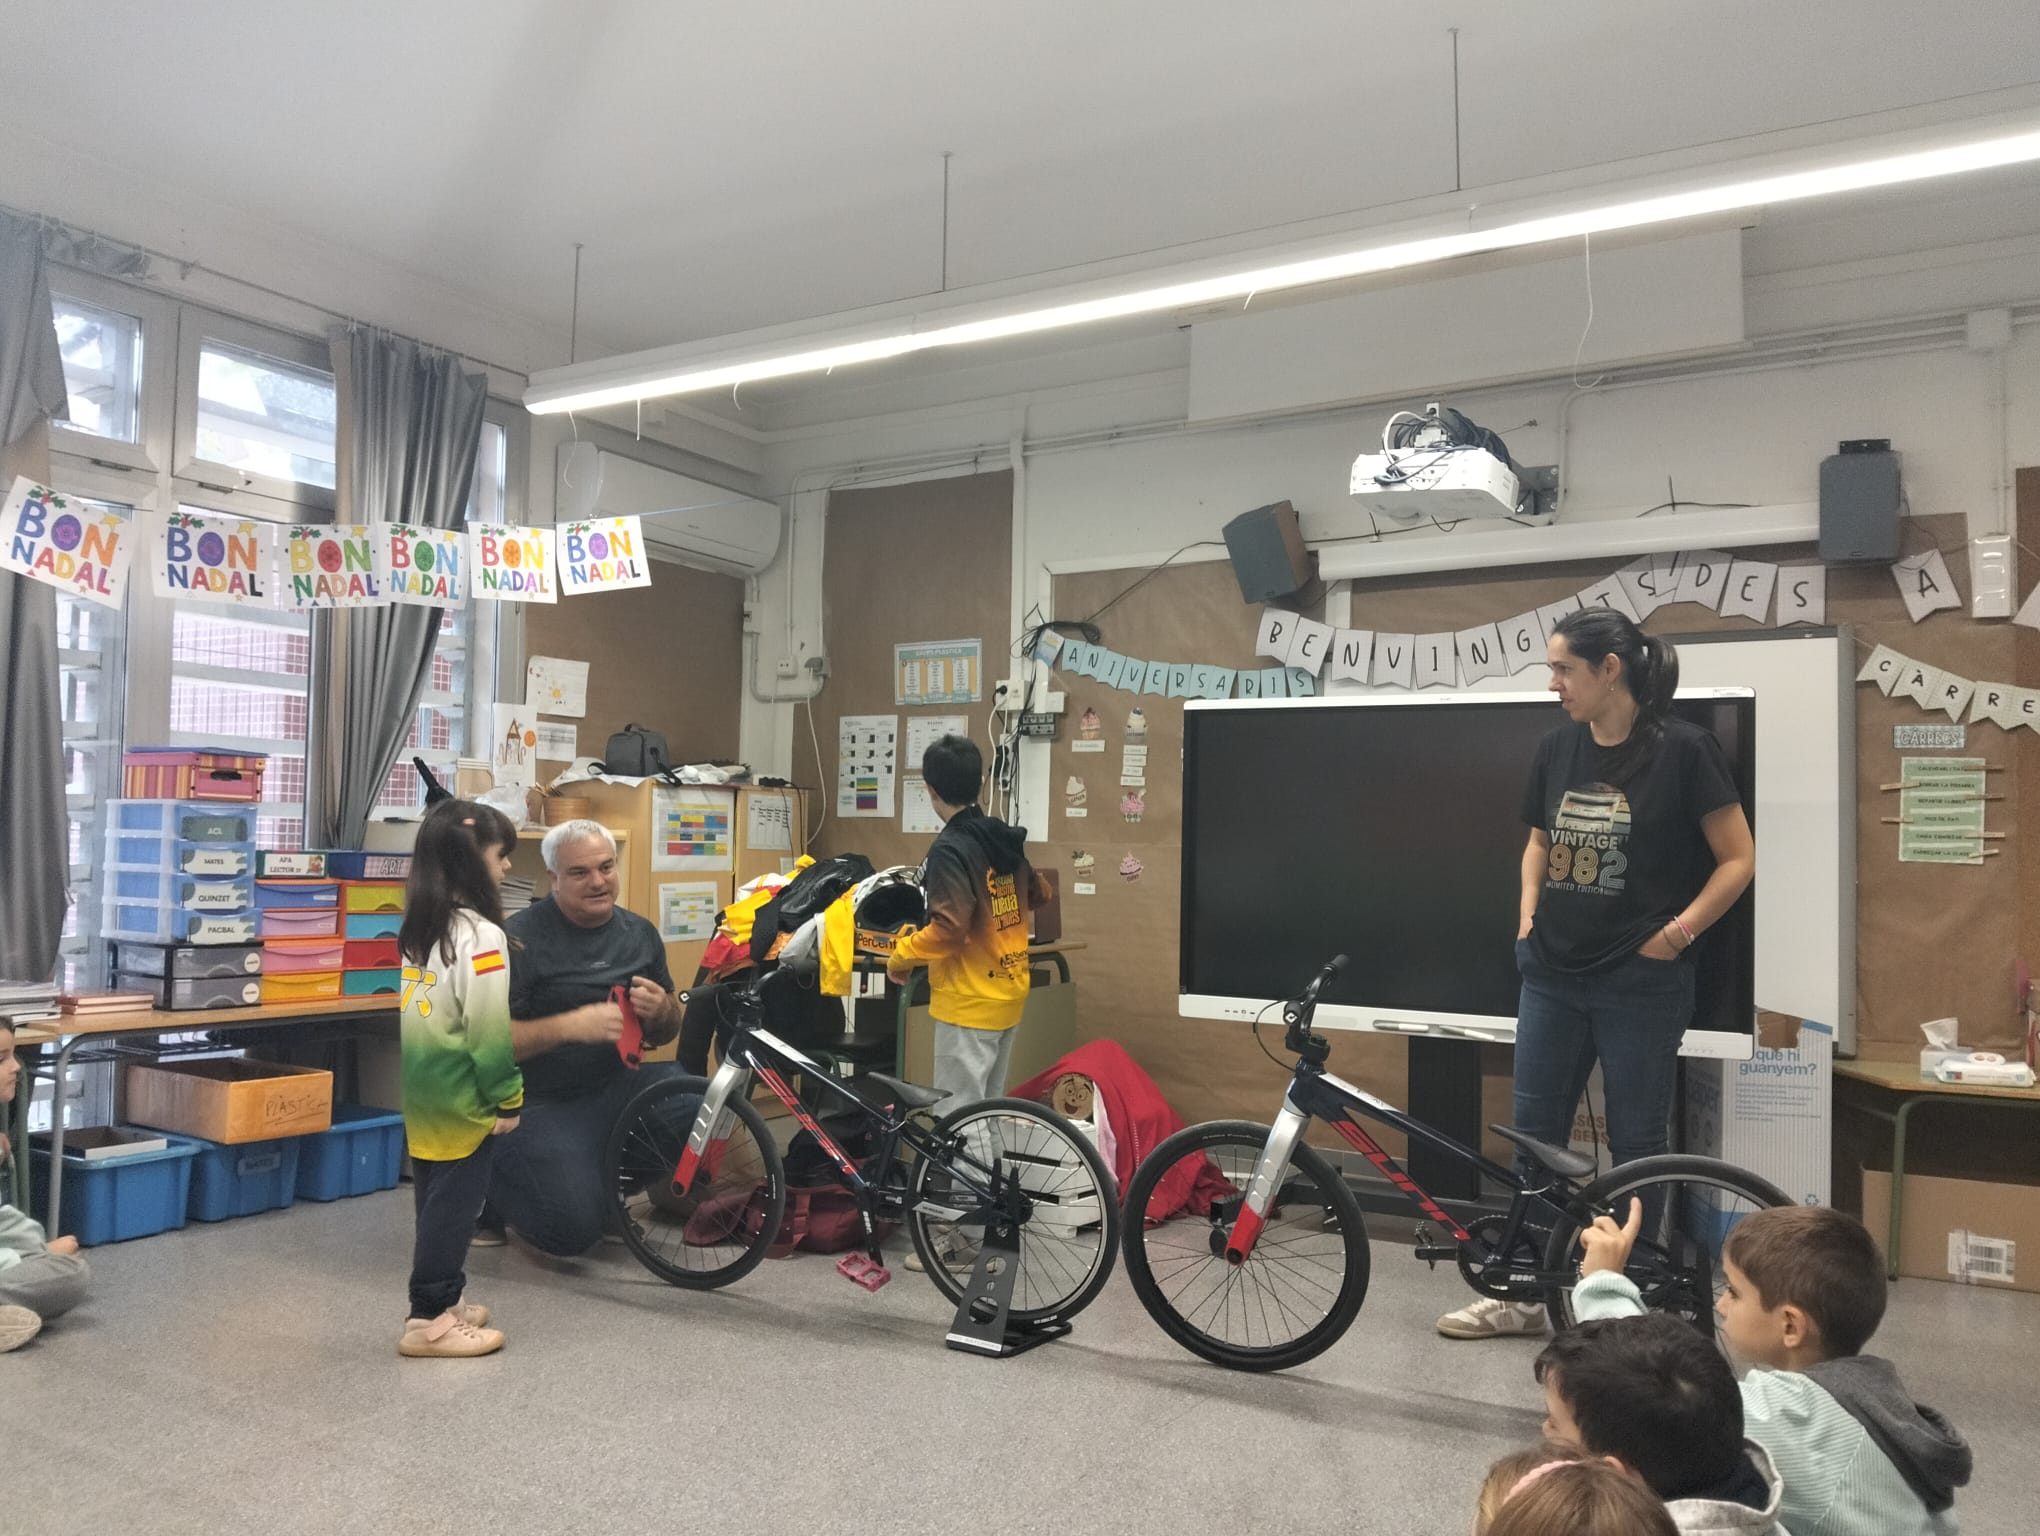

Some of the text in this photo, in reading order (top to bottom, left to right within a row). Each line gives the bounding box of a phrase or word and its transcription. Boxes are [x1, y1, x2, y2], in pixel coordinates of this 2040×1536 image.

[16, 499, 119, 568] BON
[166, 526, 258, 572] BON
[566, 530, 633, 563] BON
[11, 536, 112, 596] NADAL
[290, 539, 372, 573] BON
[391, 536, 458, 576] BON
[481, 536, 544, 570] BON
[167, 564, 263, 597] NADAL
[293, 573, 379, 599] NADAL
[391, 569, 459, 600] NADAL
[483, 567, 549, 593] NADAL
[570, 559, 641, 584] NADAL
[1917, 569, 1939, 598] A
[1068, 646, 1307, 695] ANIVERSARIS
[1550, 829, 1618, 850] VINTAGE
[1739, 1062, 1817, 1077] guanyem?
